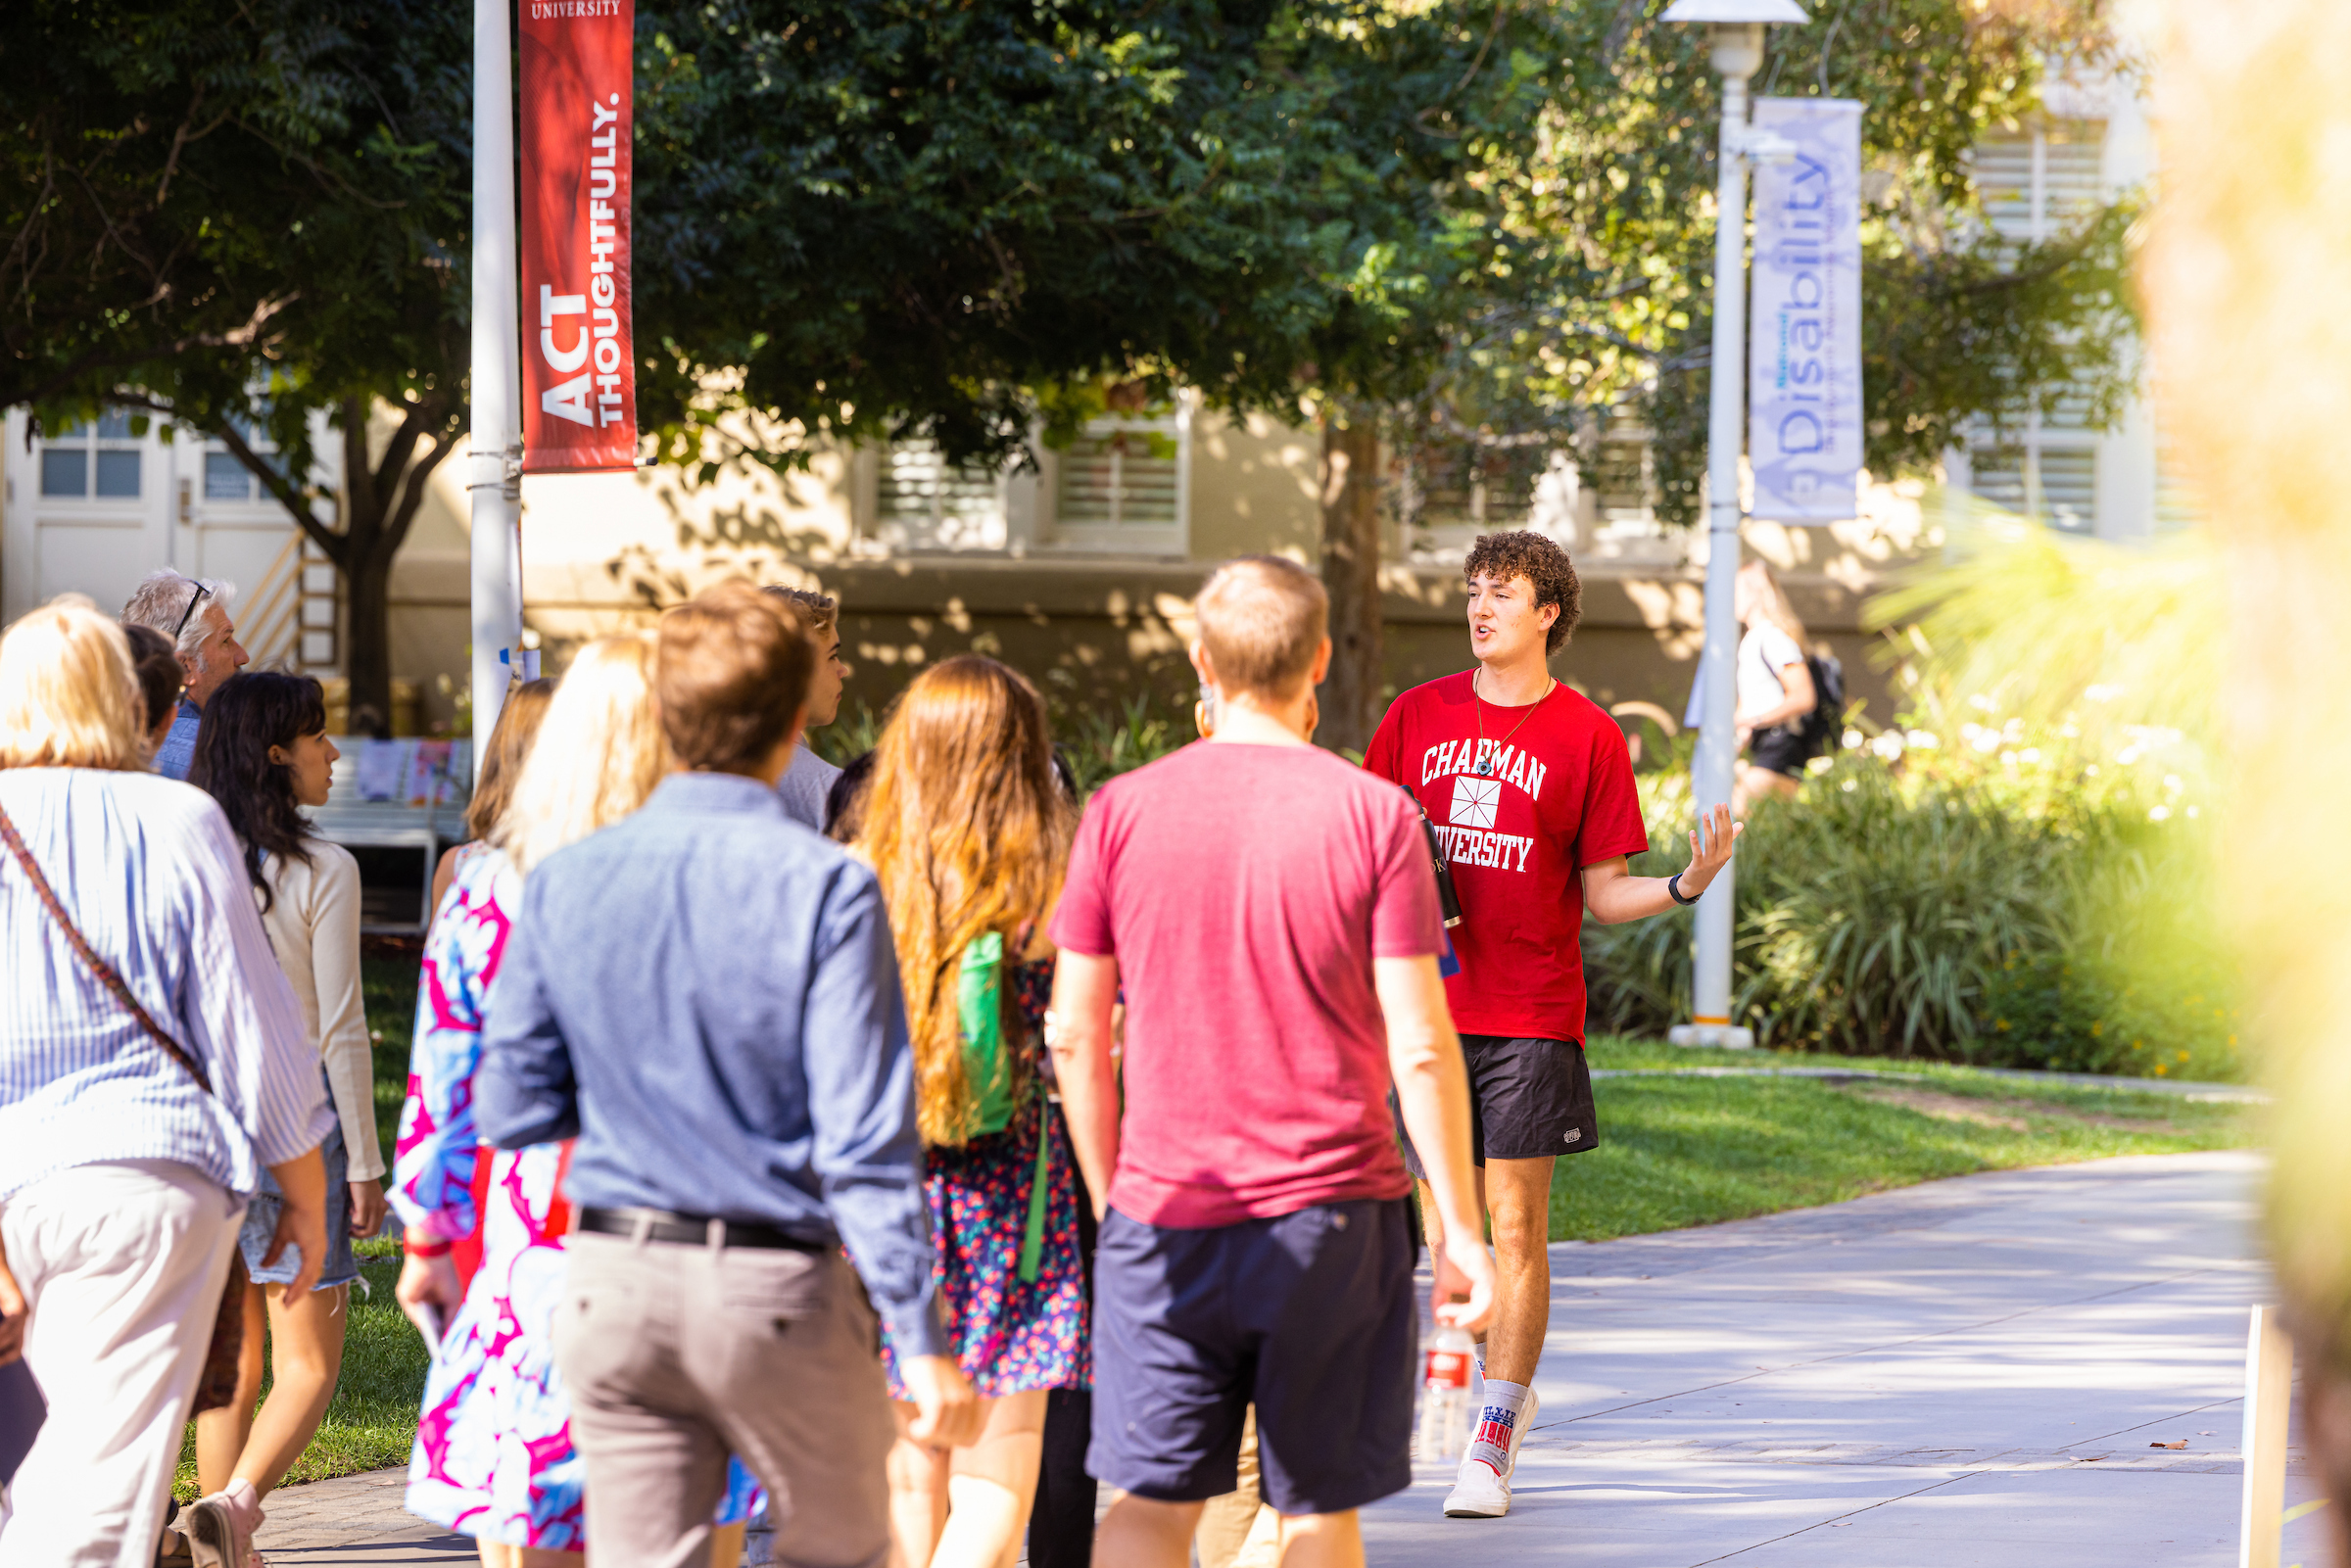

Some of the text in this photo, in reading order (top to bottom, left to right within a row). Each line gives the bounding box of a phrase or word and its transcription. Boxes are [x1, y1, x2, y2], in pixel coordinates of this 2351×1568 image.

[532, 0, 621, 20] UNIVERSITY
[590, 92, 623, 428] THOUGHTFULLY.
[1778, 152, 1831, 455] Disability
[540, 284, 594, 427] ACT
[1421, 737, 1547, 801] CHAPMAN
[1433, 825, 1534, 873] IVERSITY
